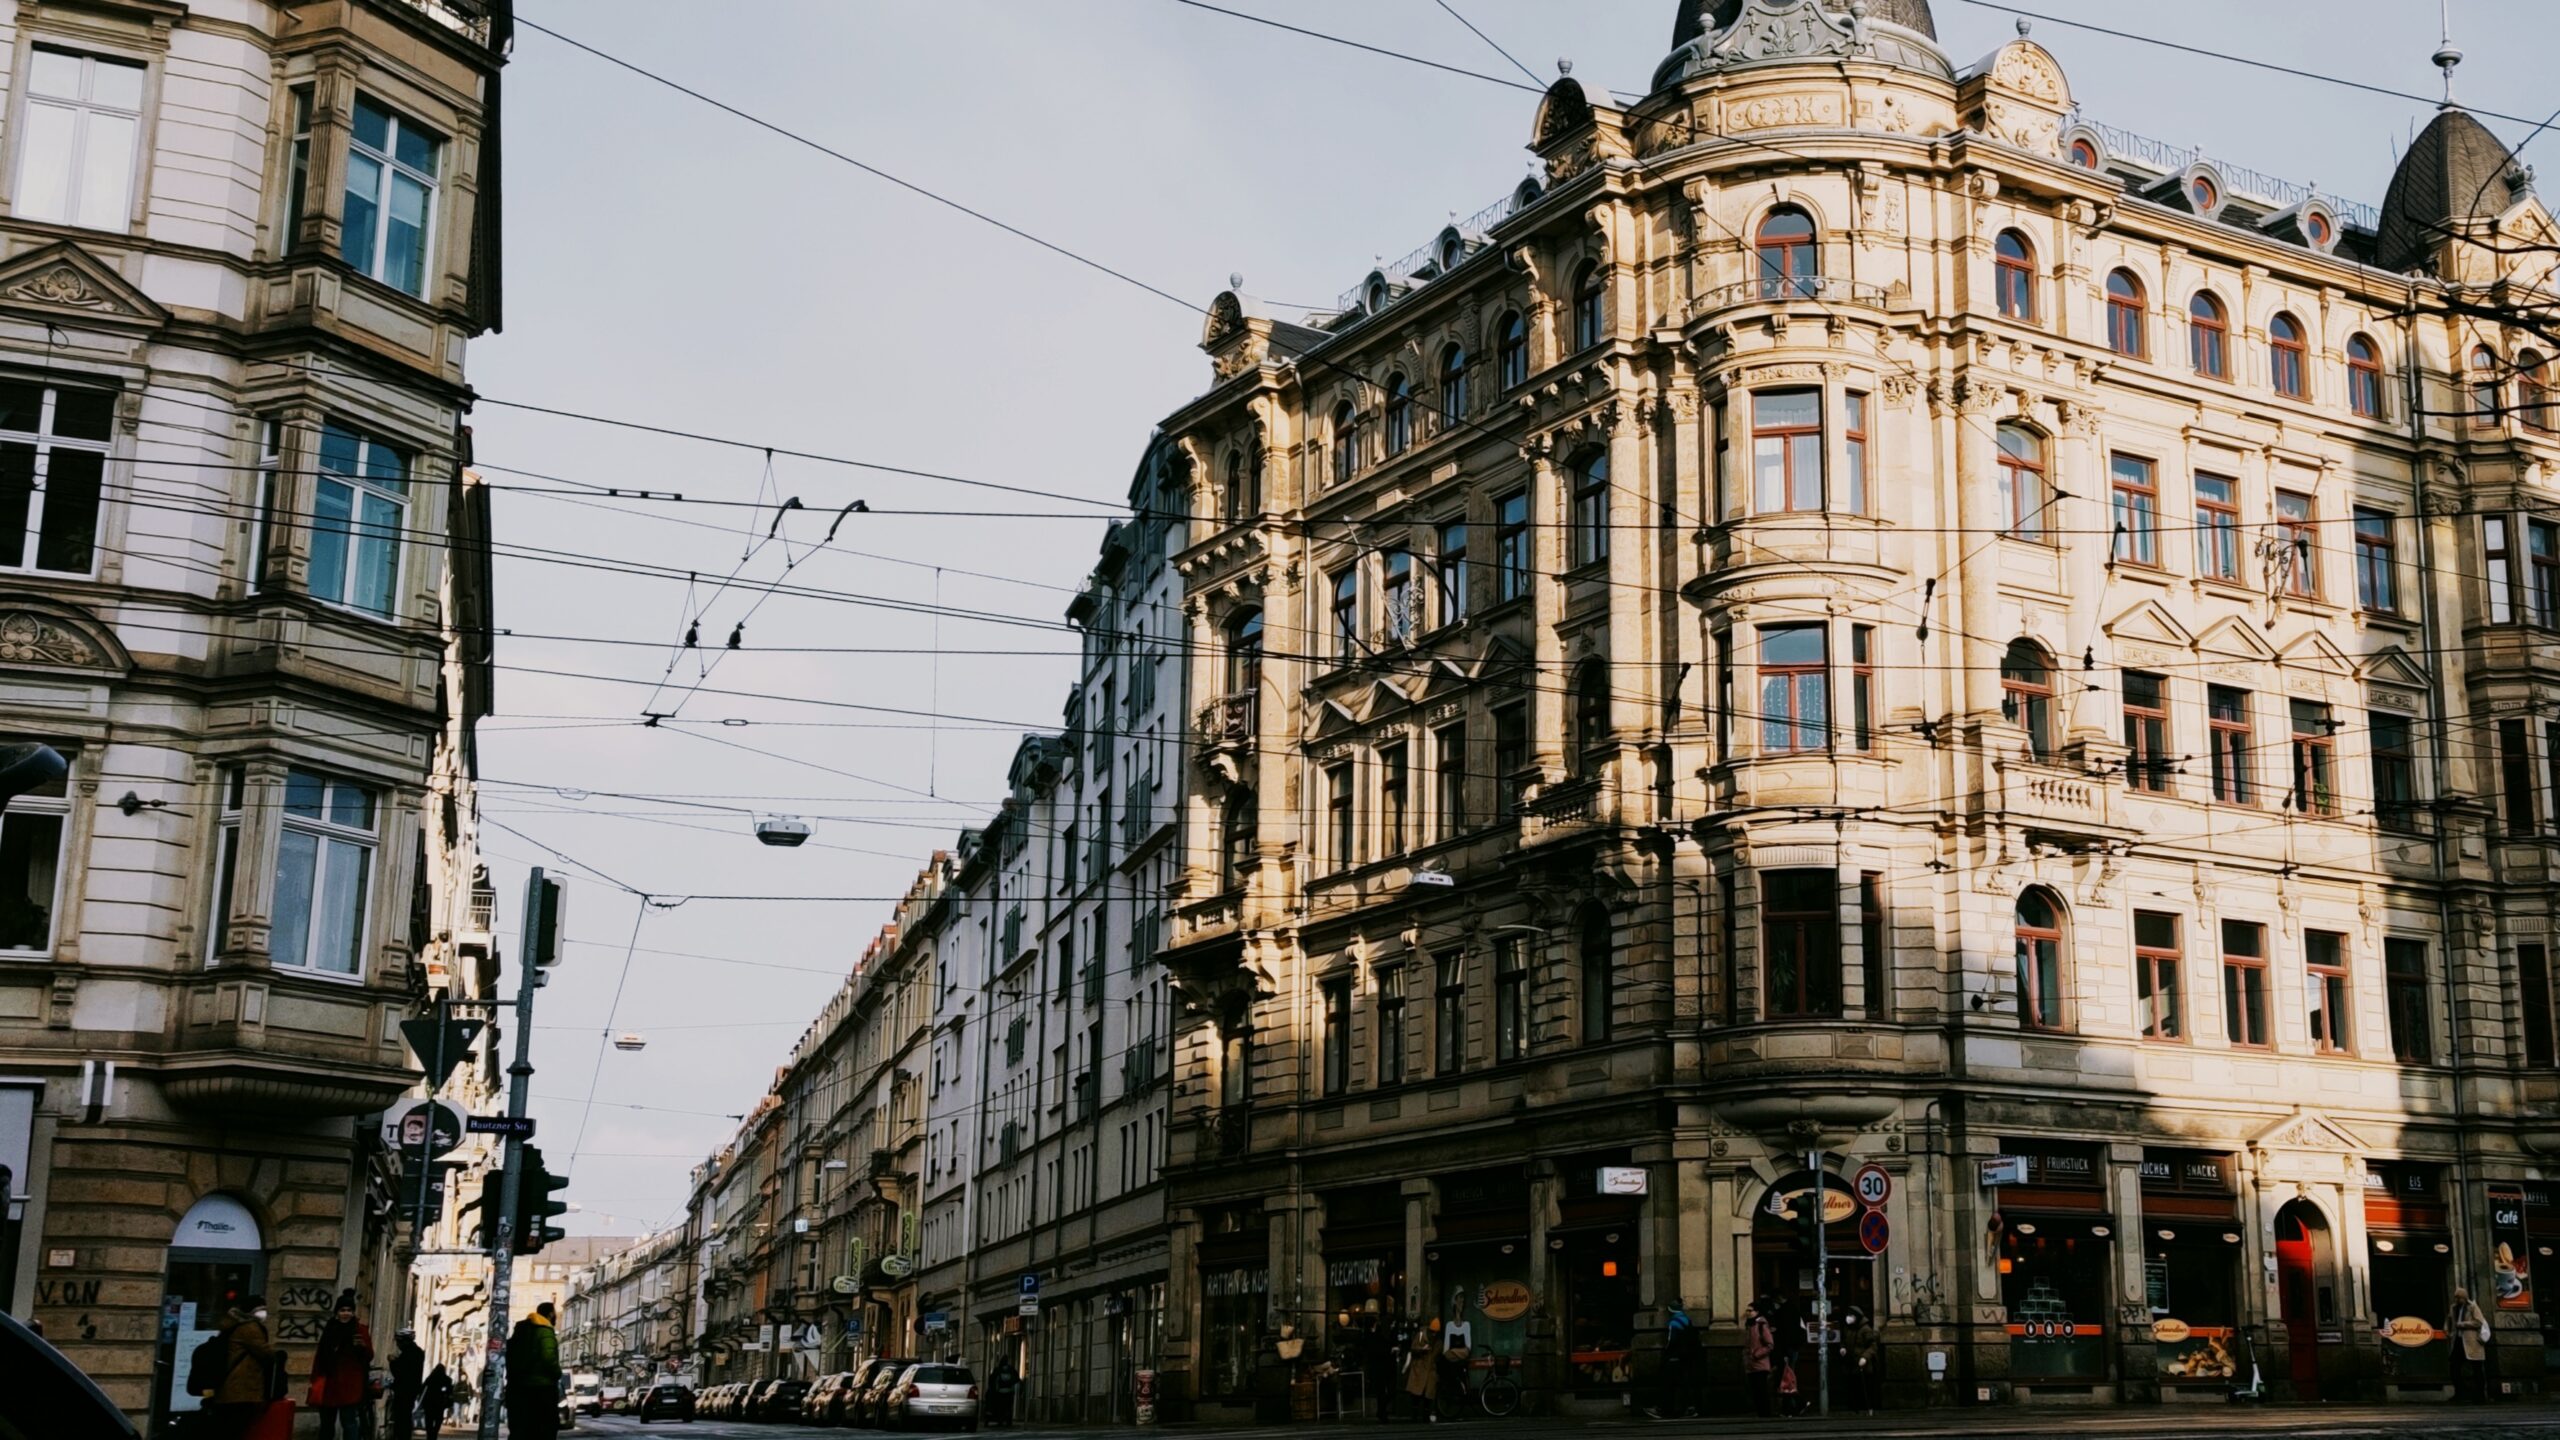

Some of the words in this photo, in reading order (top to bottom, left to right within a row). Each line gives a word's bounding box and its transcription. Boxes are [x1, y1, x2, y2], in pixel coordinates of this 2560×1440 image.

[470, 1119, 511, 1130] Bautzner
[514, 1120, 530, 1131] Str.
[2186, 1163, 2218, 1179] SNACKS
[1861, 1177, 1884, 1196] 30
[2409, 1175, 2422, 1188] EIS
[2495, 1209, 2519, 1225] Café
[1330, 1258, 1380, 1287] FLECHTWERK
[1023, 1276, 1035, 1292] P
[1206, 1271, 1240, 1297] RATTAN
[1241, 1270, 1250, 1294] &
